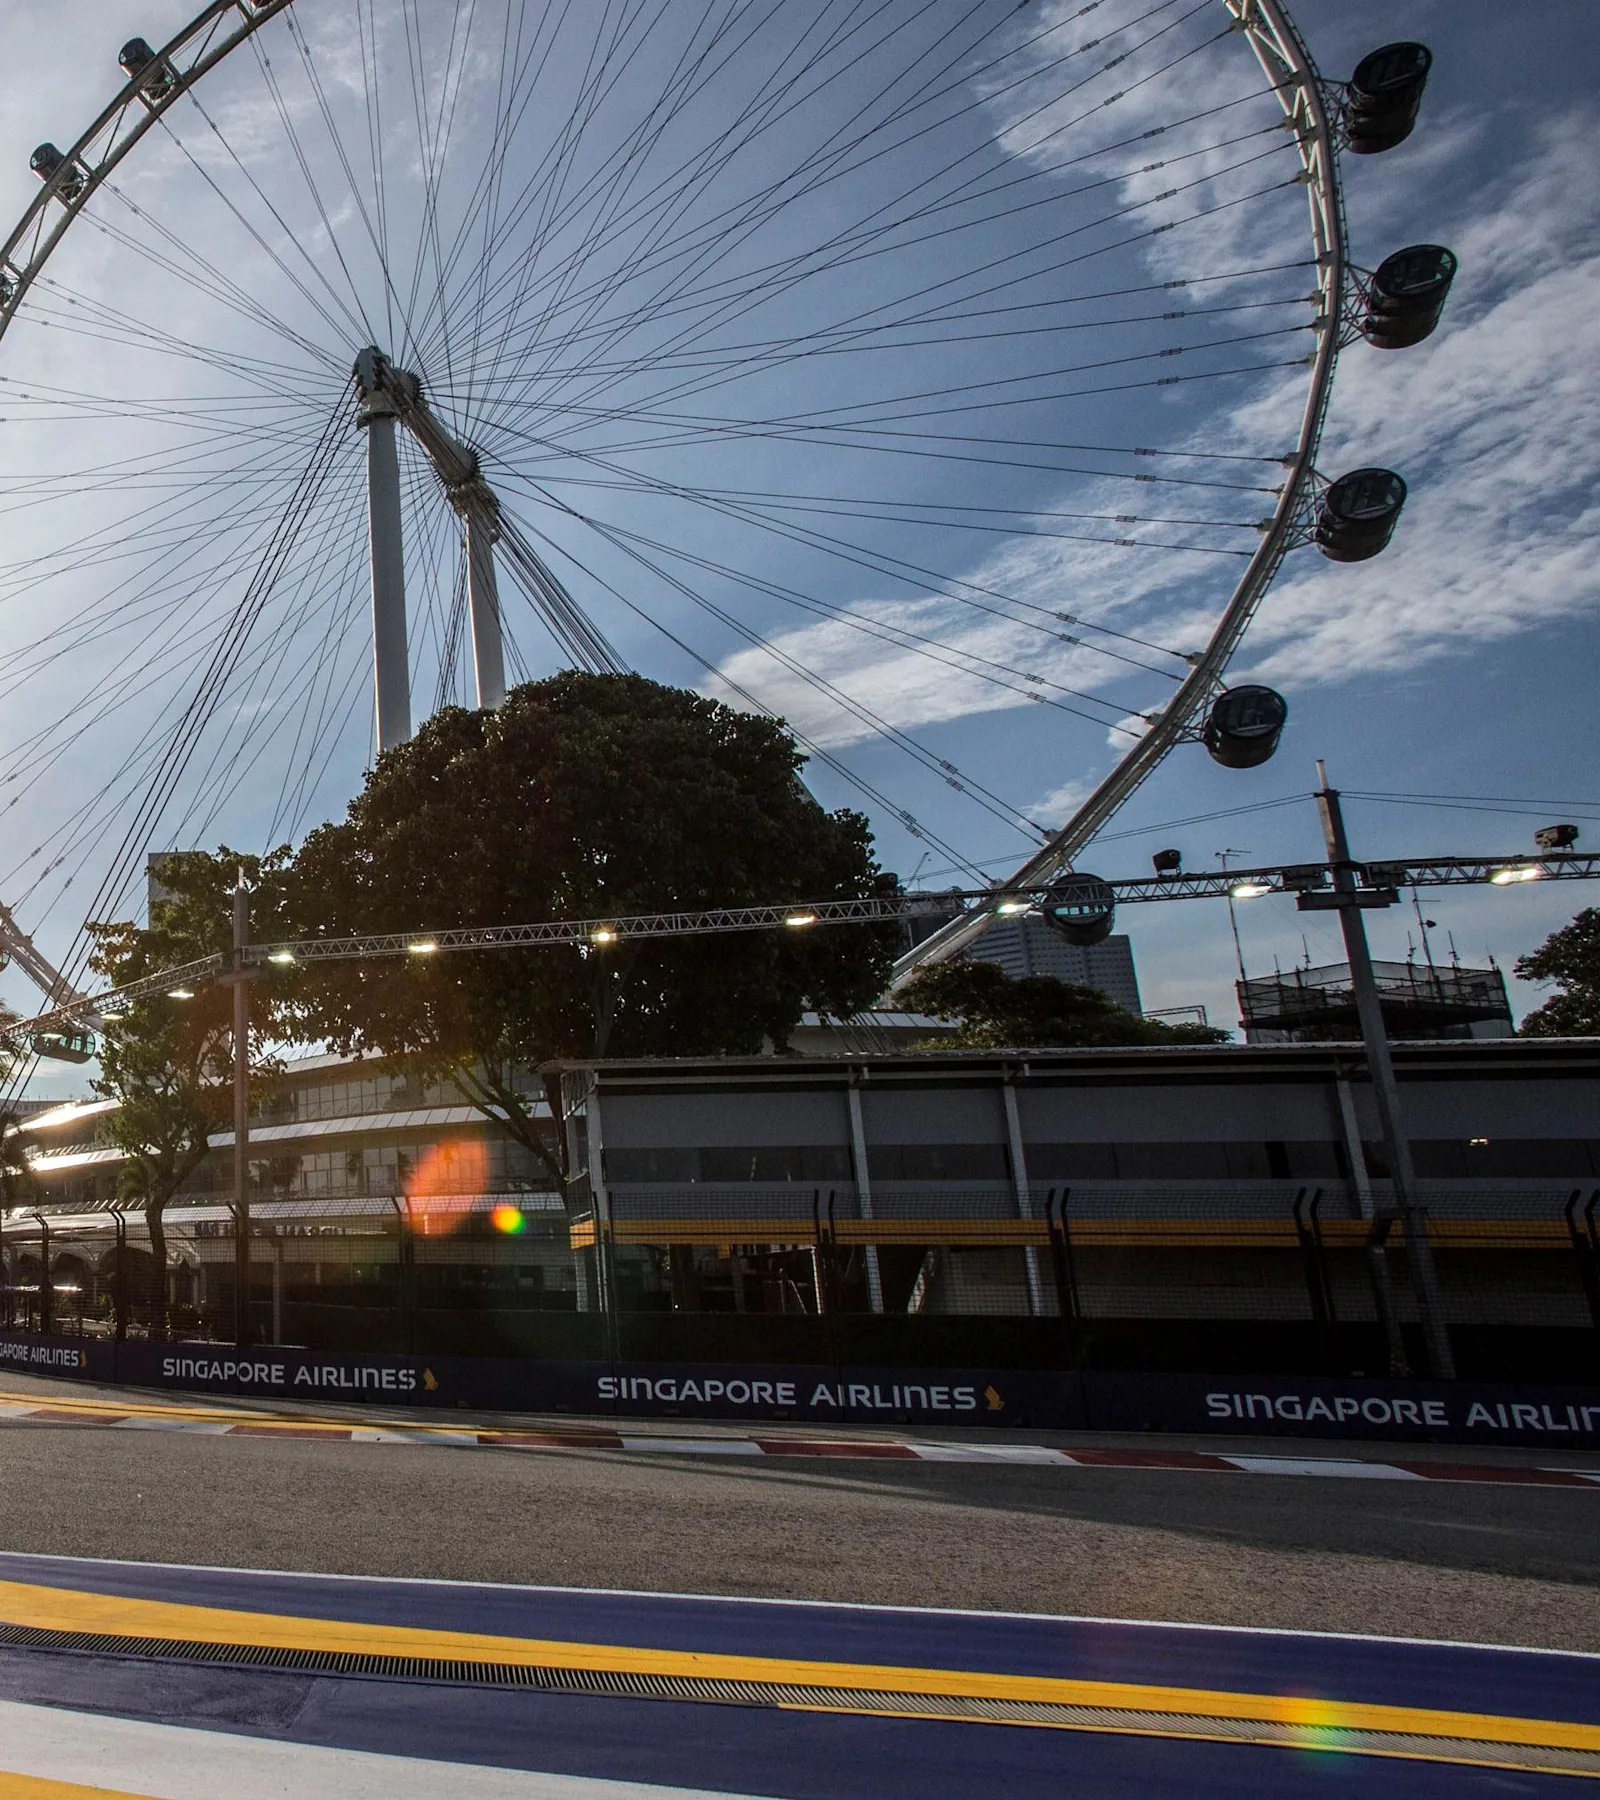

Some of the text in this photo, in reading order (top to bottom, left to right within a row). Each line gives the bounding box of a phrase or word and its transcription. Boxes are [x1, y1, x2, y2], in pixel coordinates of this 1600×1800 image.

[30, 1346, 79, 1367] AIRLINES
[162, 1358, 416, 1389] SINGAPORE AIRLINES
[597, 1377, 977, 1409] SINGAPORE AIRLINES
[1206, 1394, 1448, 1424] SINGAPORE
